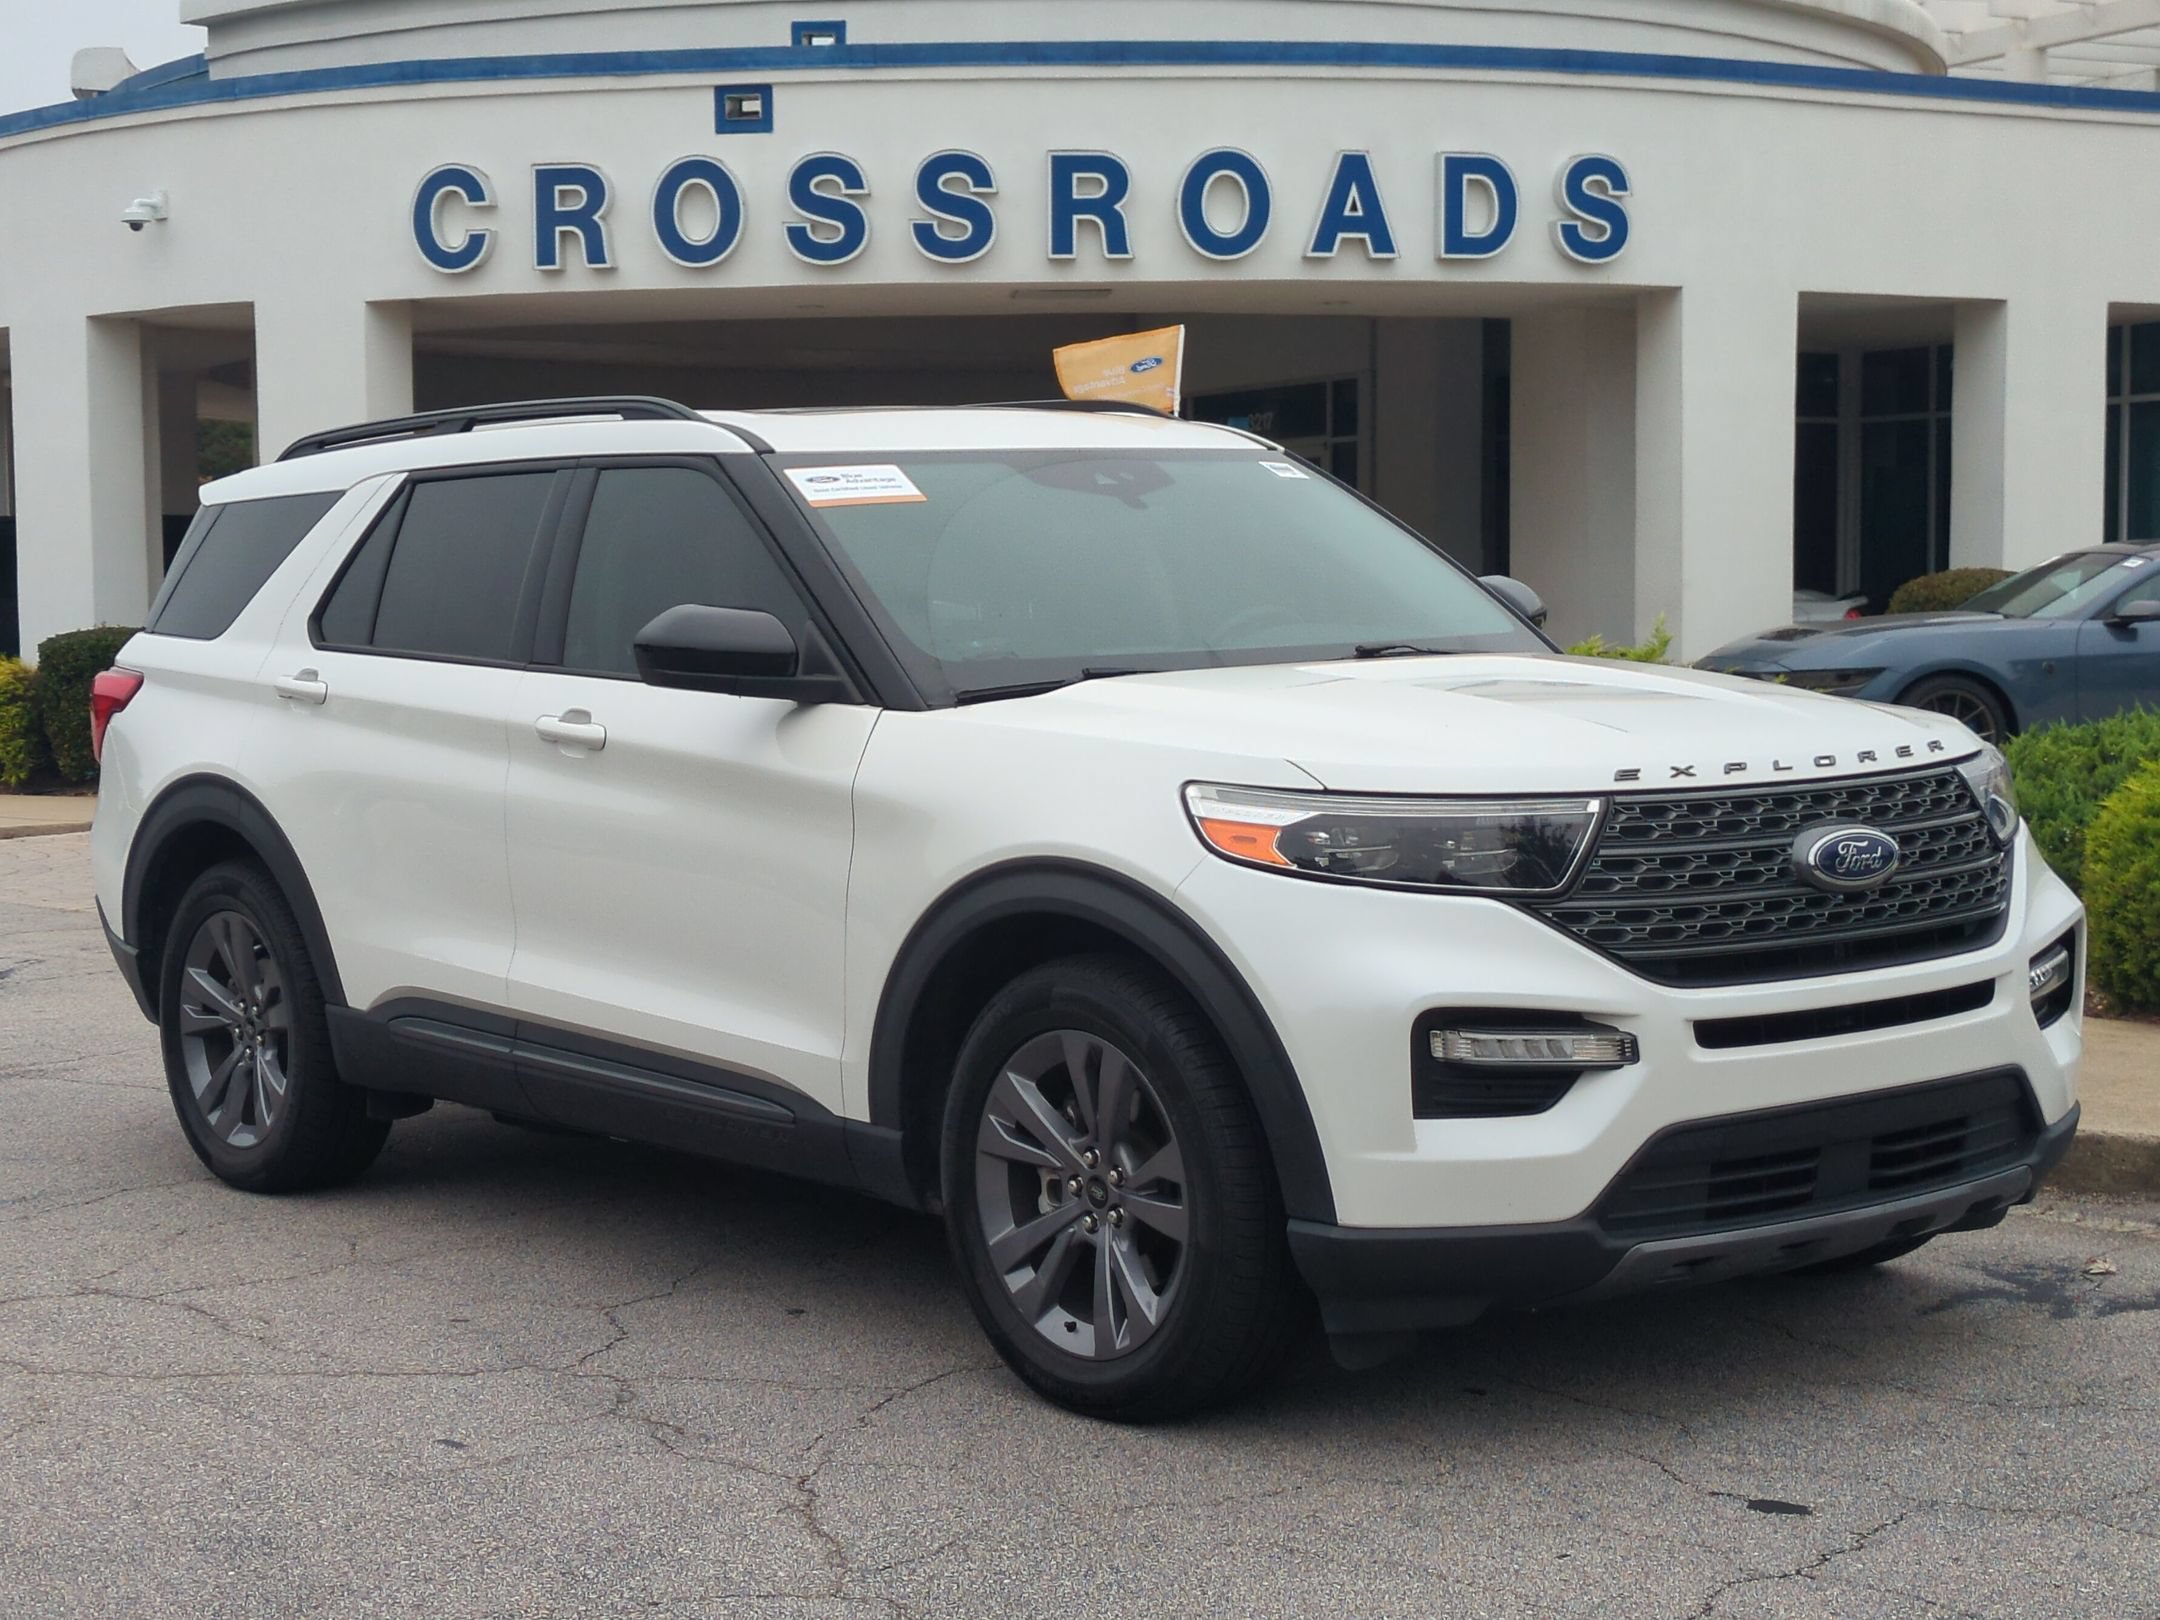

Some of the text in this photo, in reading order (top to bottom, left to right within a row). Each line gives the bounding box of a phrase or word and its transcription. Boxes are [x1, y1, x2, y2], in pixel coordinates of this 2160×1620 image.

[414, 147, 1631, 276] CROSSROADS
[1614, 740, 1945, 782] EXPLORER
[1835, 840, 1882, 872] Ford
